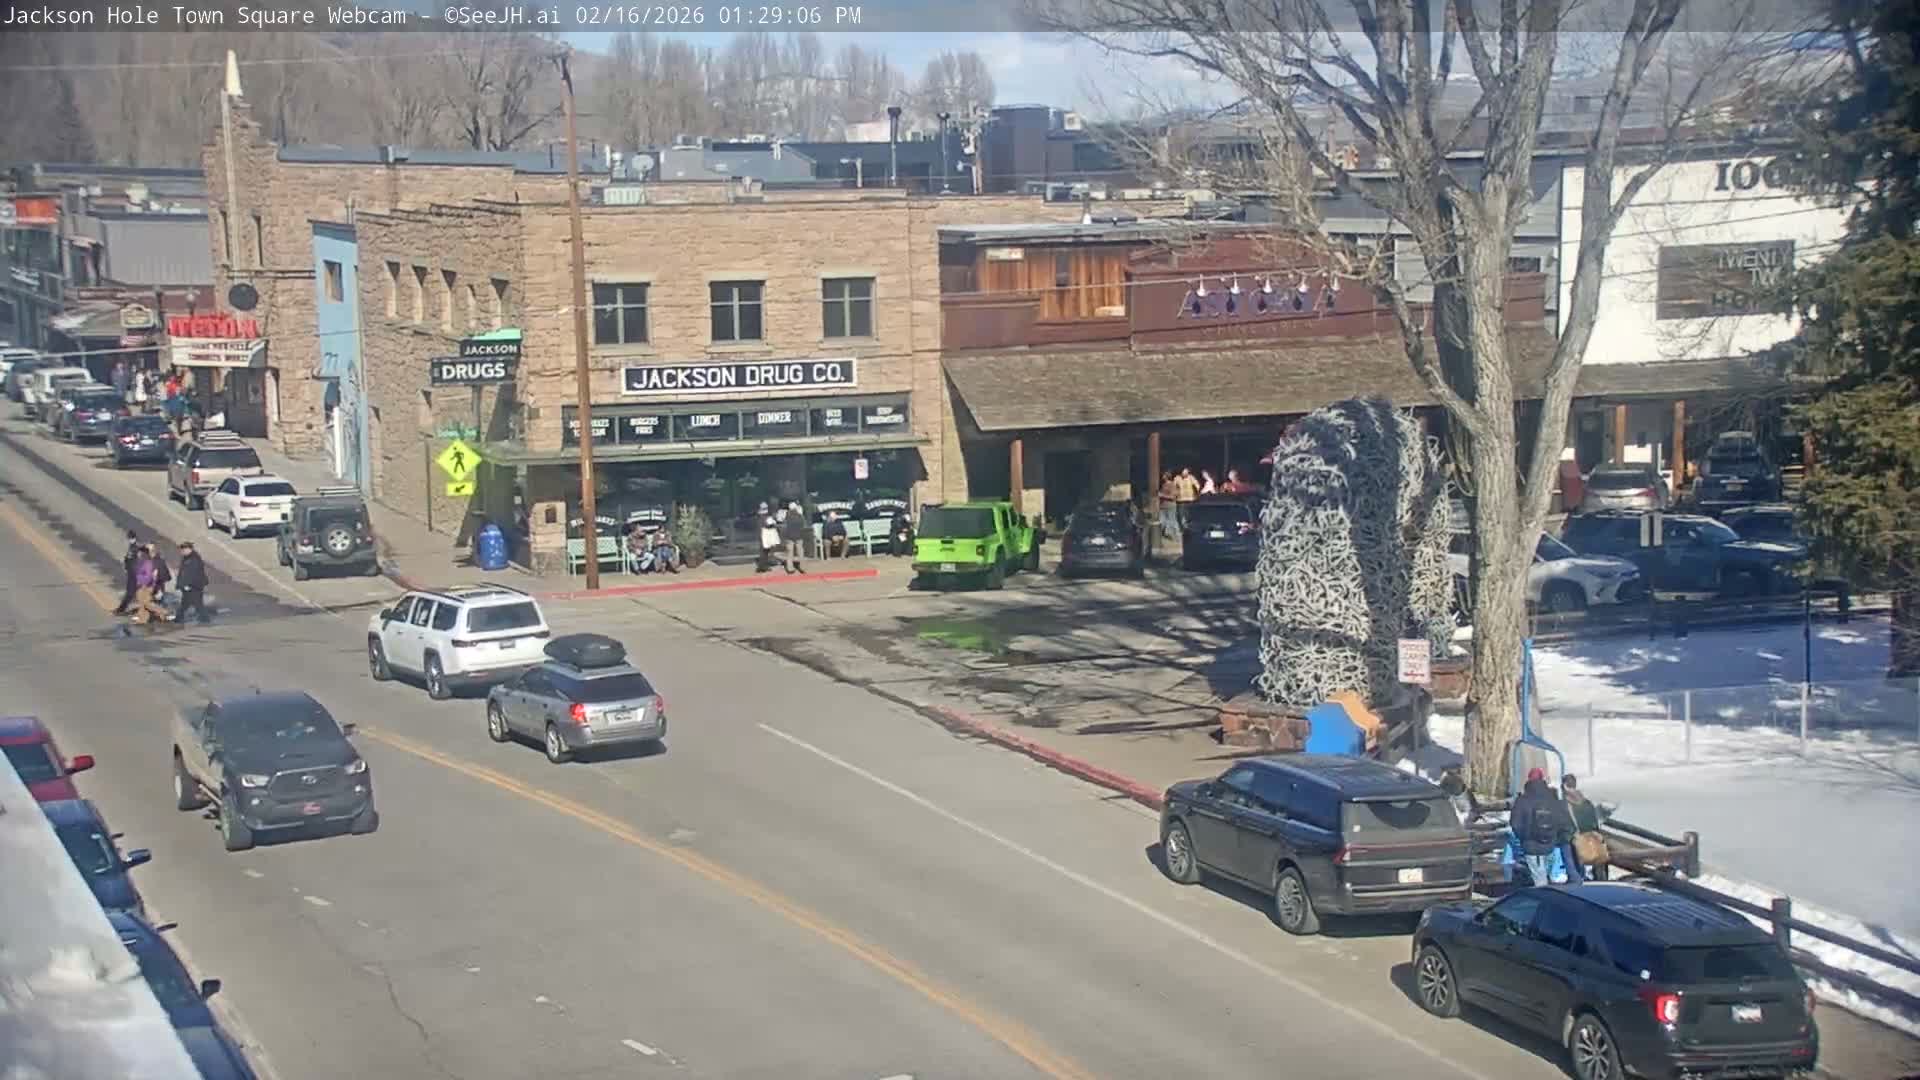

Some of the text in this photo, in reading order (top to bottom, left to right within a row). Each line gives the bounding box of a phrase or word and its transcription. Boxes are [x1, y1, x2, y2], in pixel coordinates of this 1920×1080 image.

[464, 344, 518, 356] JACKSON
[442, 362, 506, 380] DRUGS
[633, 363, 846, 389] JACKSON DRUG CO.
[690, 414, 721, 427] LUNCH
[757, 411, 792, 425] DINNER
